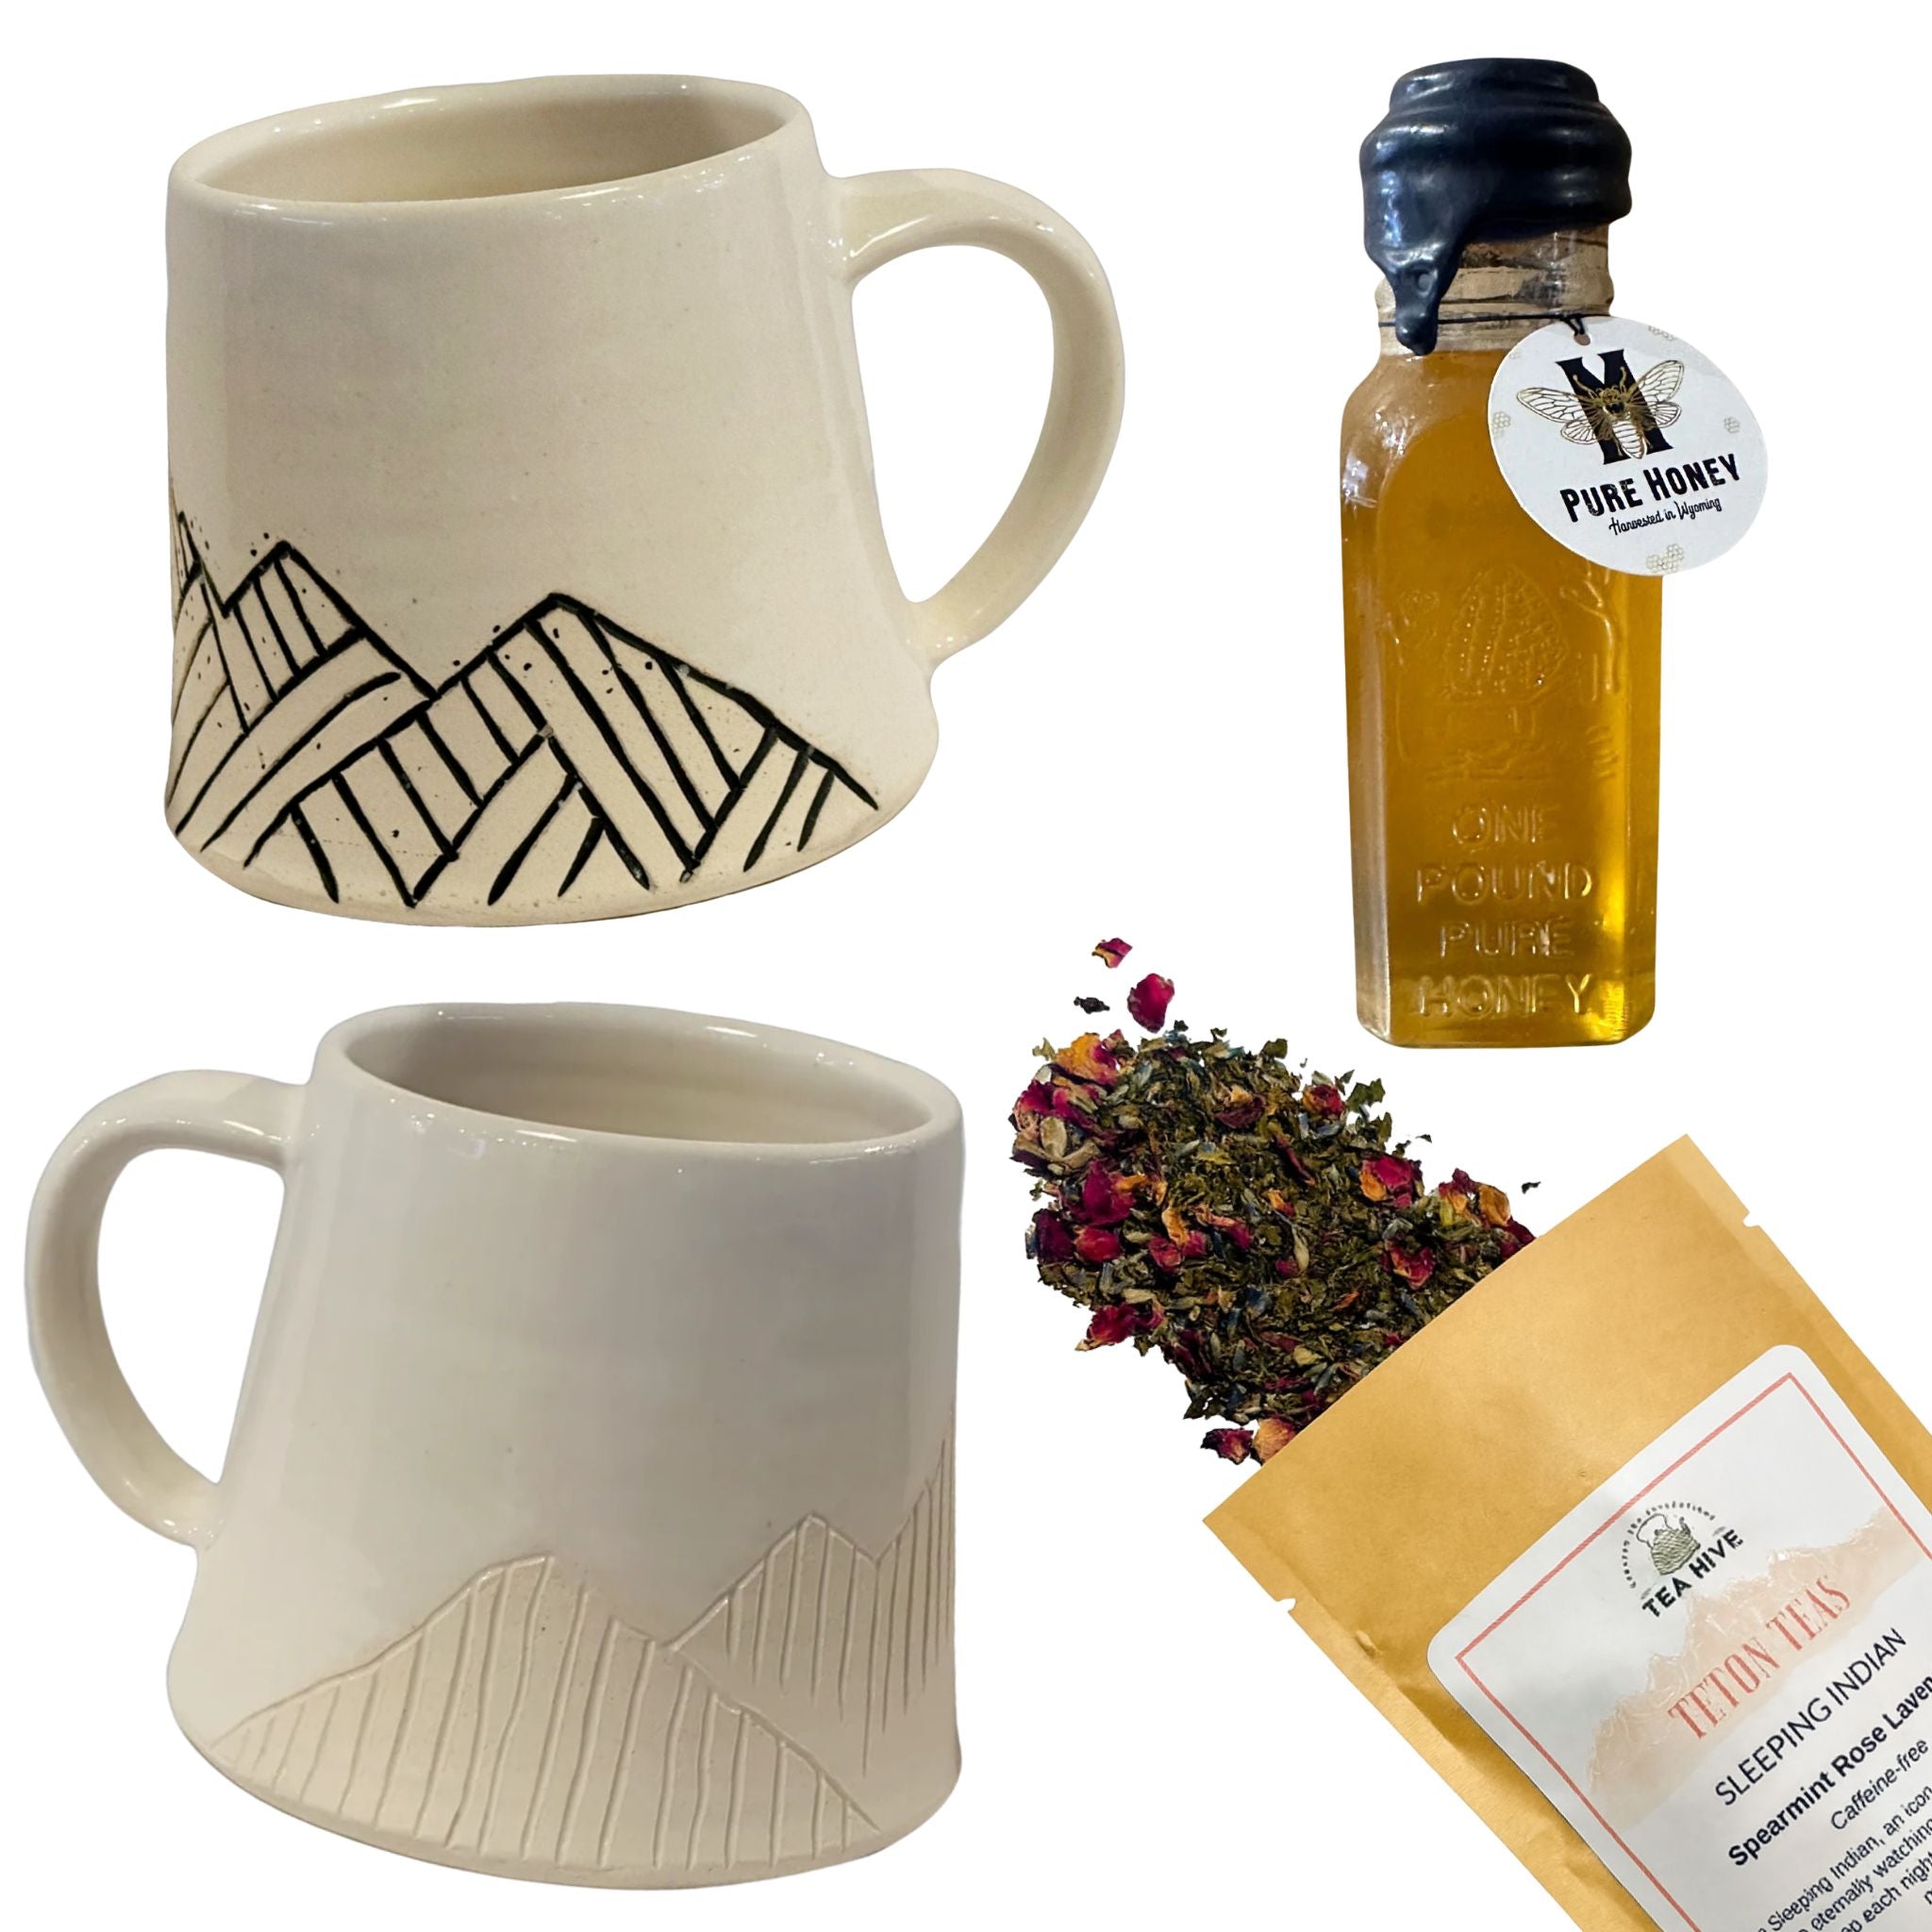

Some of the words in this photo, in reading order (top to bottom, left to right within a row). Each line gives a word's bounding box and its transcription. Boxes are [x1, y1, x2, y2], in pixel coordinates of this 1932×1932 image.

[1559, 478, 1643, 523] PURE
[1642, 454, 1740, 501] HONEY
[1608, 511, 1664, 535] Harvested
[1664, 509, 1675, 521] in
[1674, 497, 1723, 520] Wyoming
[1452, 804, 1553, 843] ONE
[1417, 862, 1591, 903] POUND
[1440, 916, 1574, 958] PURE
[1418, 974, 1592, 1016] HONEY
[1641, 1577, 1692, 1618] TEA
[1688, 1529, 1743, 1579] HIVE
[1667, 1637, 1780, 1740] TETON
[1765, 1577, 1851, 1652] TEAS
[1715, 1697, 1832, 1806] SLEEPING
[1824, 1627, 1907, 1707] INDIAN
[1728, 1772, 1836, 1866] Spearmint
[1831, 1726, 1888, 1777] Rose
[1830, 1739, 1929, 1830] Caffeine-free
[1767, 1876, 1834, 1931] Sleeping
[1829, 1836, 1886, 1879] Indian,
[1883, 1814, 1906, 1836] an
[1810, 1874, 1874, 1931] eternally
[1862, 1886, 1902, 1923] each
